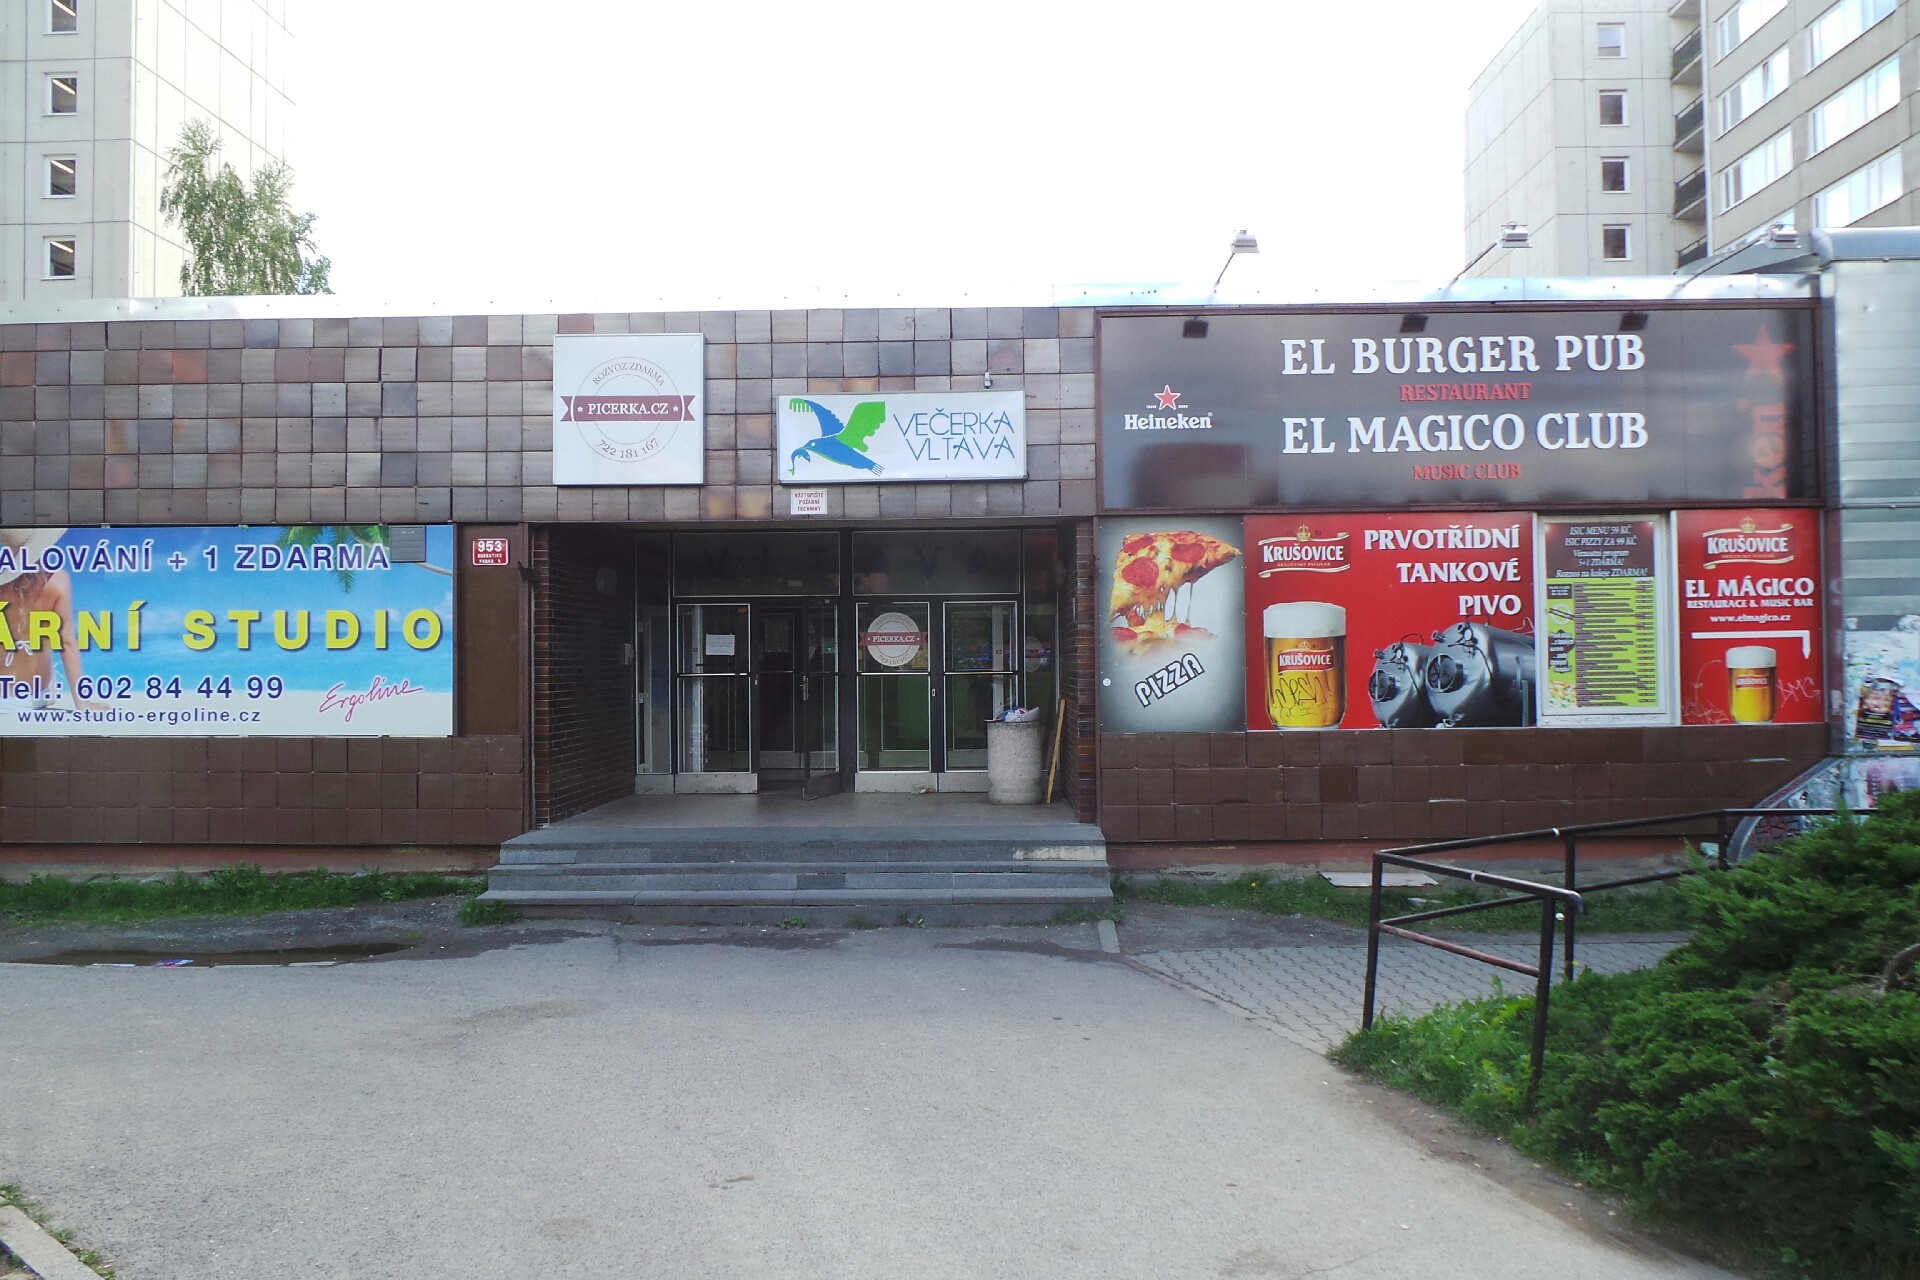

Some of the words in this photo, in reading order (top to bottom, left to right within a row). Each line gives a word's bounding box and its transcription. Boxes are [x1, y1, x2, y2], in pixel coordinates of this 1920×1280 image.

[1281, 339, 1336, 375] EL
[1351, 335, 1541, 374] BURGER
[1555, 334, 1647, 371] PUB
[593, 362, 627, 385] ROZVOZ
[629, 362, 665, 386] ZDARMA
[1400, 383, 1533, 402] RESTAURANT
[588, 402, 669, 415] PICERKA.CZ
[893, 408, 1015, 438] VEČERKA
[1123, 413, 1212, 430] Heineken
[1282, 417, 1336, 454] EL
[1347, 413, 1526, 454] MAGICO
[1536, 412, 1650, 450] CLUB
[595, 440, 617, 455] 722
[620, 449, 639, 458] 181
[642, 437, 659, 454] 167
[906, 436, 1016, 461] VLTAVA
[1413, 464, 1472, 481] MUSIC
[1474, 463, 1522, 480] CLUB
[1364, 524, 1521, 550] PRVOTŘÍDNÍ
[1585, 526, 1610, 535] MENU
[477, 540, 502, 553] 953
[1603, 537, 1615, 546] ZA
[1707, 535, 1789, 554] KRUŠOVICE
[0, 539, 154, 571] ALOVÁNÍ
[168, 552, 188, 571] +
[204, 548, 218, 571] 1
[235, 544, 392, 571] ZDARMA
[1263, 543, 1344, 563] KRUŠOVICE
[1396, 558, 1521, 583] TANKOVÉ
[1685, 579, 1711, 598] EL
[1717, 575, 1815, 597] MÁGICO
[1459, 594, 1522, 616] PIVO
[1687, 599, 1749, 609] RESTAURACE
[1749, 599, 1759, 608] &
[1761, 598, 1792, 608] MUSIC
[1793, 598, 1814, 608] BAR
[1710, 613, 1792, 624] www.elmagico.cz
[183, 608, 444, 651] STUDIO
[872, 635, 915, 643] PICERKA.CZ
[1279, 652, 1332, 667] KRUŠOVICE
[0, 676, 63, 700] Tel.:
[77, 676, 132, 700] 602
[146, 676, 183, 700] 84
[197, 676, 233, 699] 44
[247, 676, 283, 699] 99
[1135, 653, 1205, 708] PIZZA
[319, 676, 424, 723] Ergoline
[17, 707, 261, 726] www.studio-ergoline.cz
